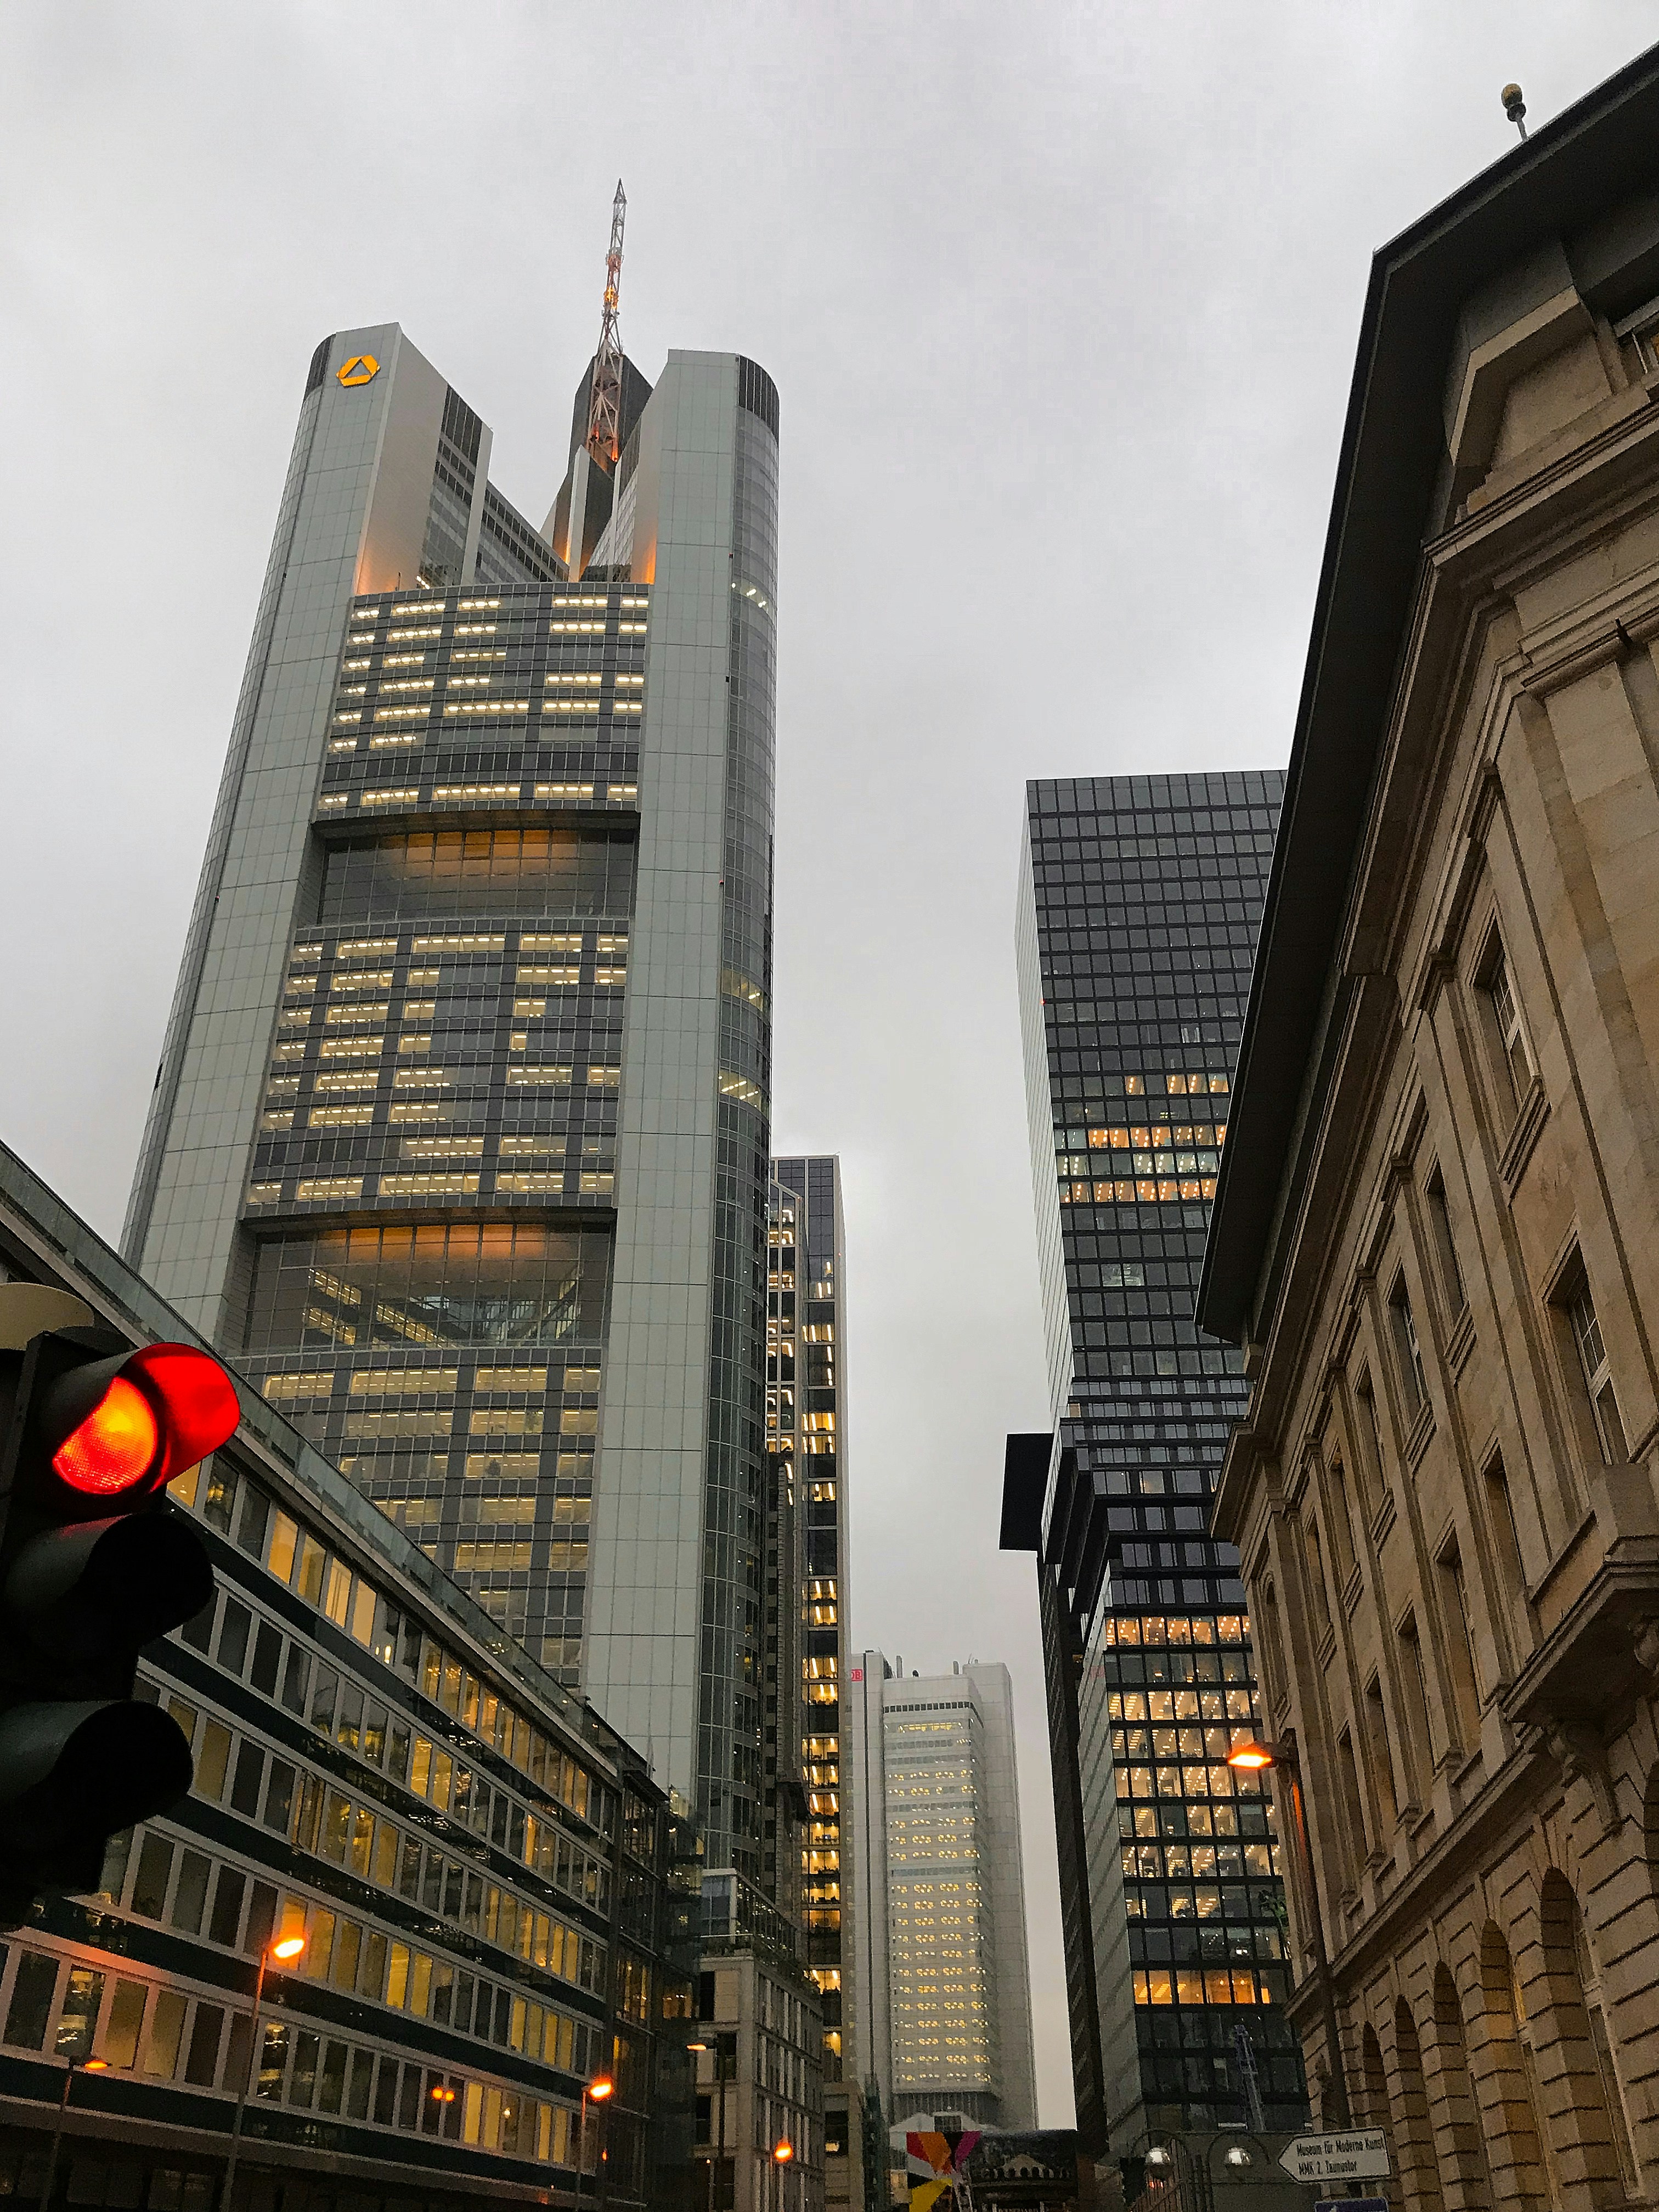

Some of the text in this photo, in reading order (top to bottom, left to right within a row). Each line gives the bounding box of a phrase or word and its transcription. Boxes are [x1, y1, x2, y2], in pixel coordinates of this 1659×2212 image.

[1296, 2136, 1384, 2157] Museum für Moderne Kunst
